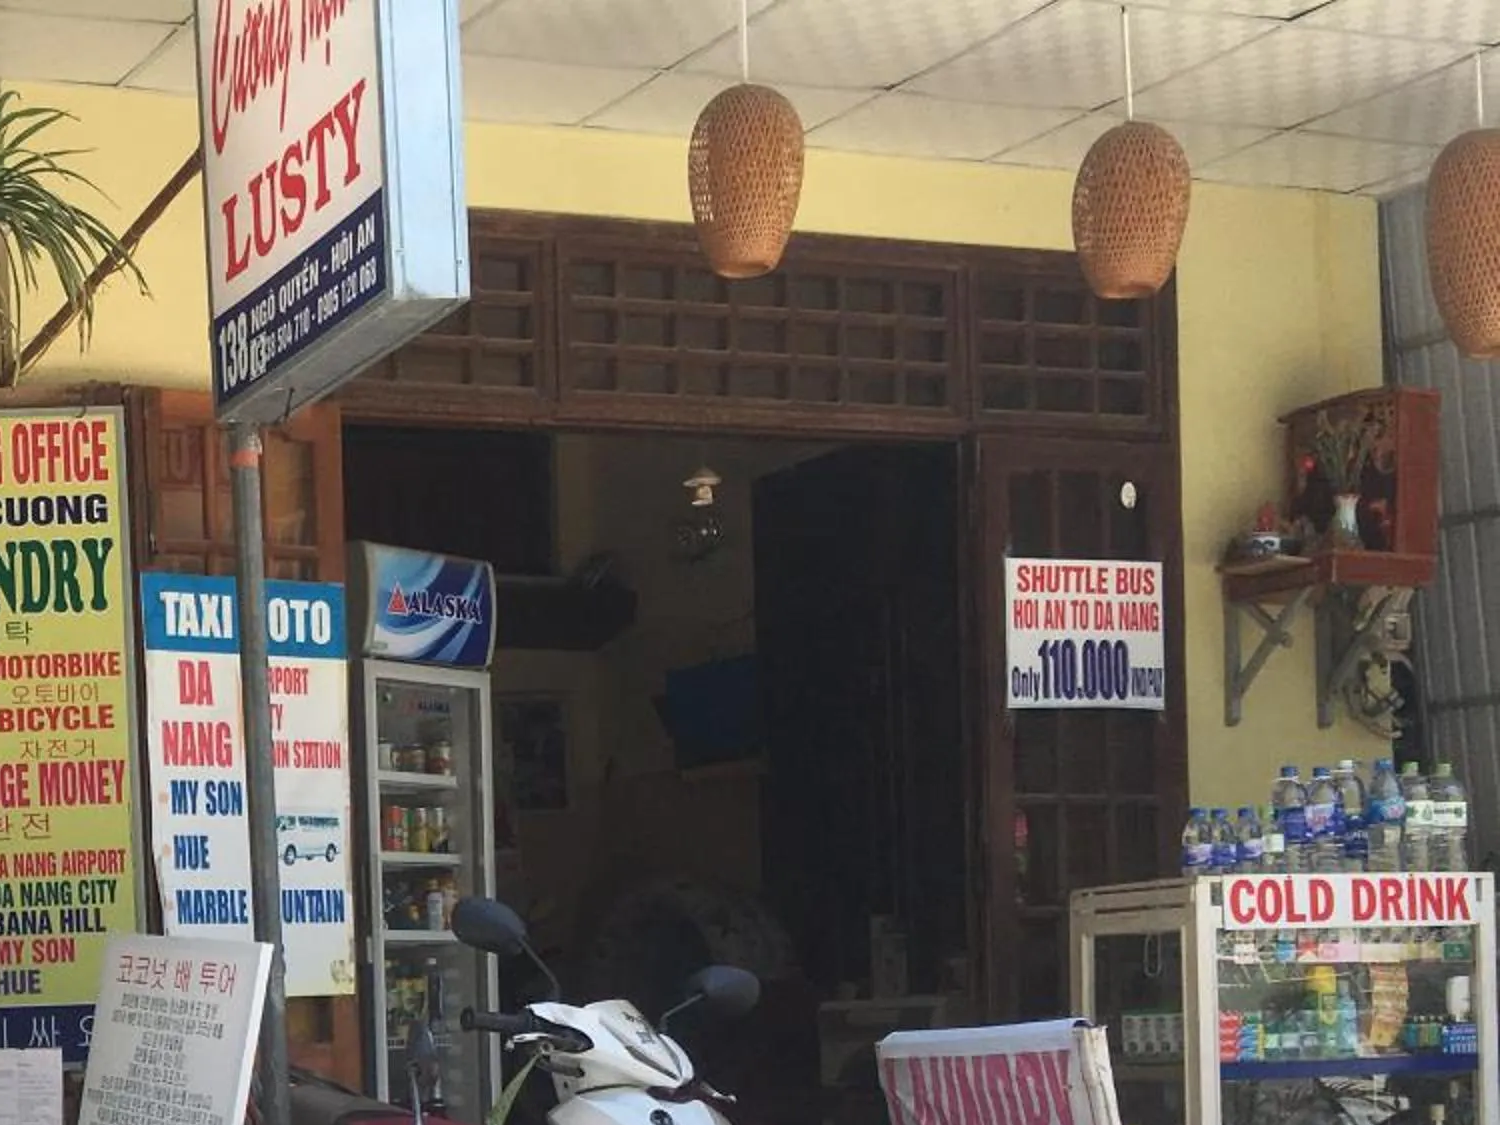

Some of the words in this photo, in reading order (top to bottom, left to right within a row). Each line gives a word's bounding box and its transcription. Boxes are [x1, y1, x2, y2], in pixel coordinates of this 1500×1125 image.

[220, 78, 367, 283] LUSTY
[218, 311, 250, 393] 138
[356, 212, 376, 255] AN
[11, 420, 110, 485] OFFICE
[1017, 565, 1108, 595] SHUTTLE
[1115, 567, 1156, 596] BUS
[160, 590, 233, 640] TAXI
[267, 598, 331, 646] OTO
[406, 589, 484, 625] ALASKA
[1013, 599, 1040, 631] HOI
[1043, 600, 1066, 631] AN
[1071, 600, 1090, 631] TO
[1093, 600, 1115, 632] DA
[1118, 601, 1160, 633] NANG
[178, 659, 215, 707] DA
[1011, 665, 1041, 702] Only
[161, 719, 233, 769] NANG
[293, 740, 342, 769] STATION
[39, 759, 126, 808] MONEY
[170, 778, 201, 816] MY
[205, 780, 243, 817] SON
[13, 852, 57, 878] NANG
[62, 848, 127, 877] AIRPORT
[173, 834, 211, 871] HUE
[20, 880, 73, 908] NANG
[78, 879, 118, 905] CITY
[176, 889, 249, 926] MARBLE
[1228, 874, 1335, 924] COLD
[1350, 872, 1471, 922] DRINK
[60, 907, 107, 934] HILL
[32, 938, 76, 965] SON
